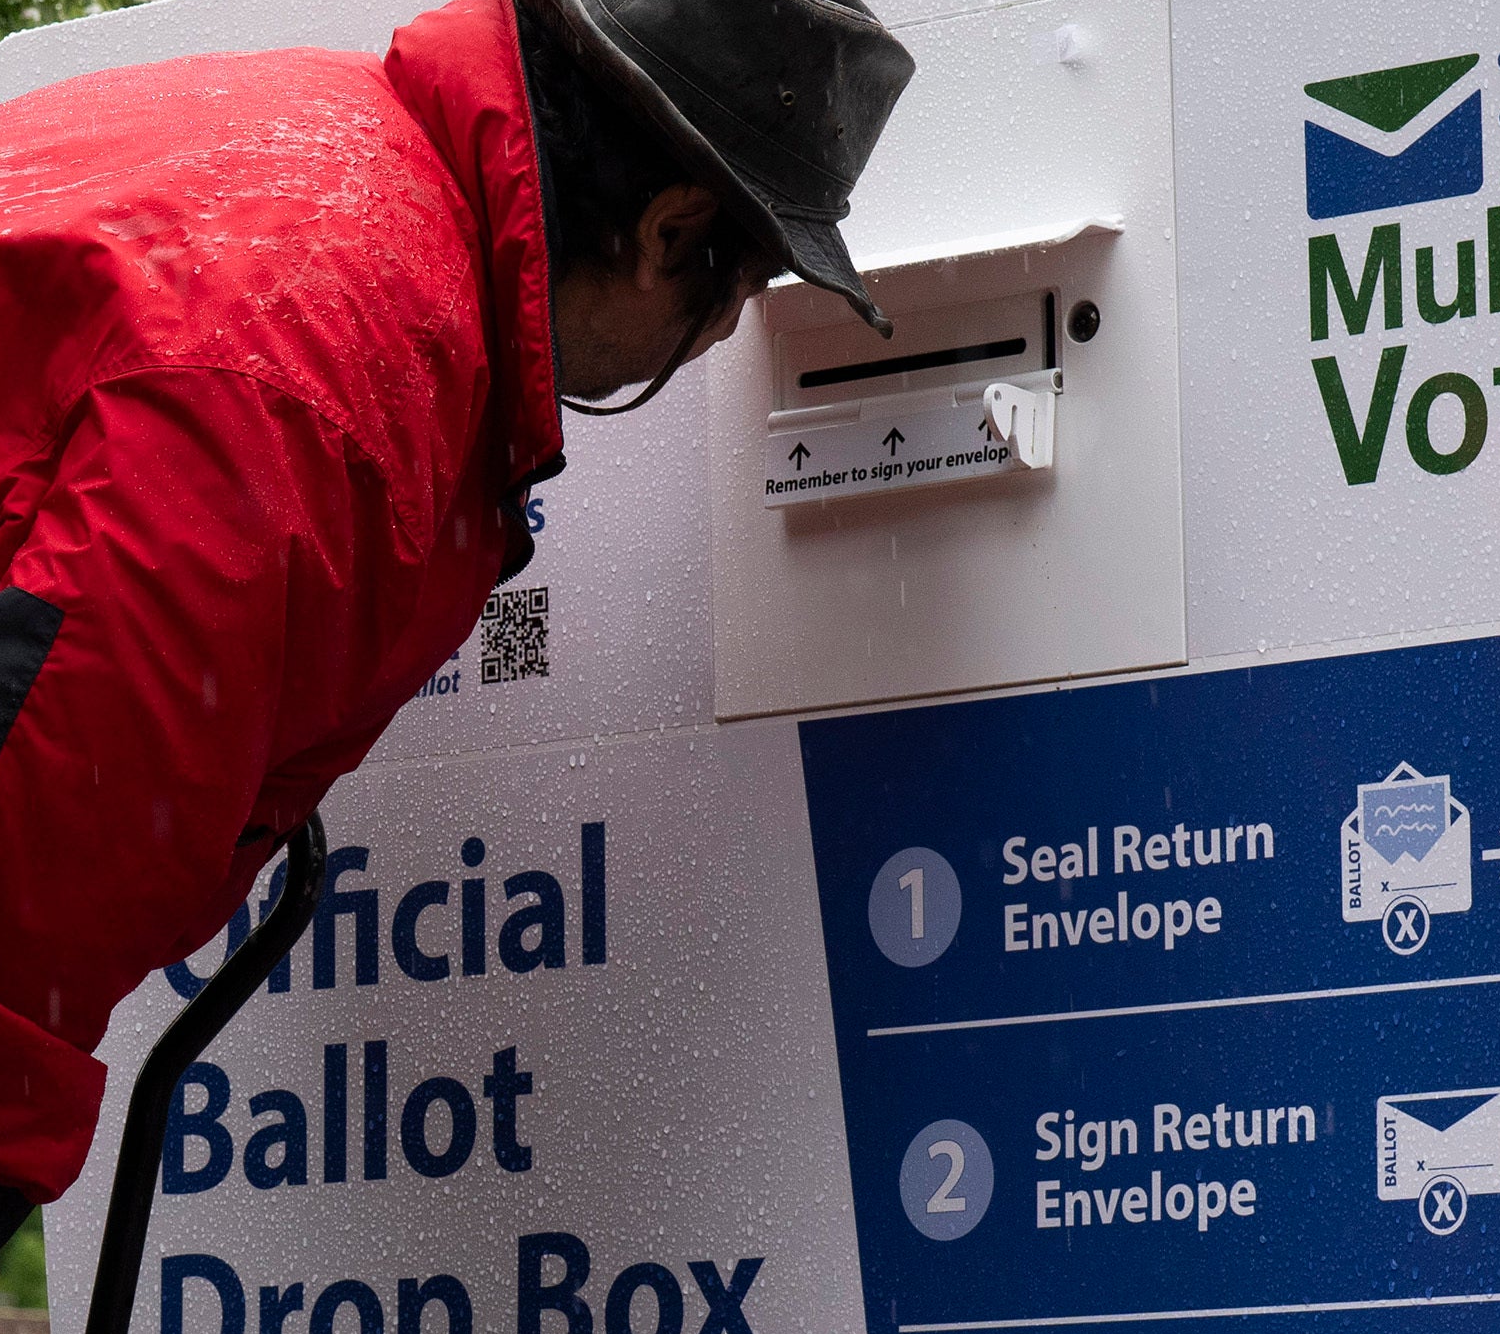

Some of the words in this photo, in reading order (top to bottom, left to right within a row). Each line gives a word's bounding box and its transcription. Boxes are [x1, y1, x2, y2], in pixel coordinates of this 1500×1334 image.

[765, 467, 848, 495] Remember
[851, 466, 868, 482] to
[870, 460, 903, 483] sign
[906, 455, 943, 478] your
[945, 445, 1013, 468] envelop
[1001, 825, 1100, 886] Seal
[1113, 818, 1275, 878] Return
[1349, 839, 1362, 909] BALLOT
[897, 868, 926, 939] 1
[1002, 896, 1224, 953] Envelope
[161, 1039, 533, 1196] Ballot
[1034, 1110, 1139, 1173] Sign
[1153, 1099, 1316, 1153] Return
[1384, 1117, 1397, 1187] BALLOT
[925, 1139, 967, 1216] 2
[1035, 1176, 1257, 1233] Envelope
